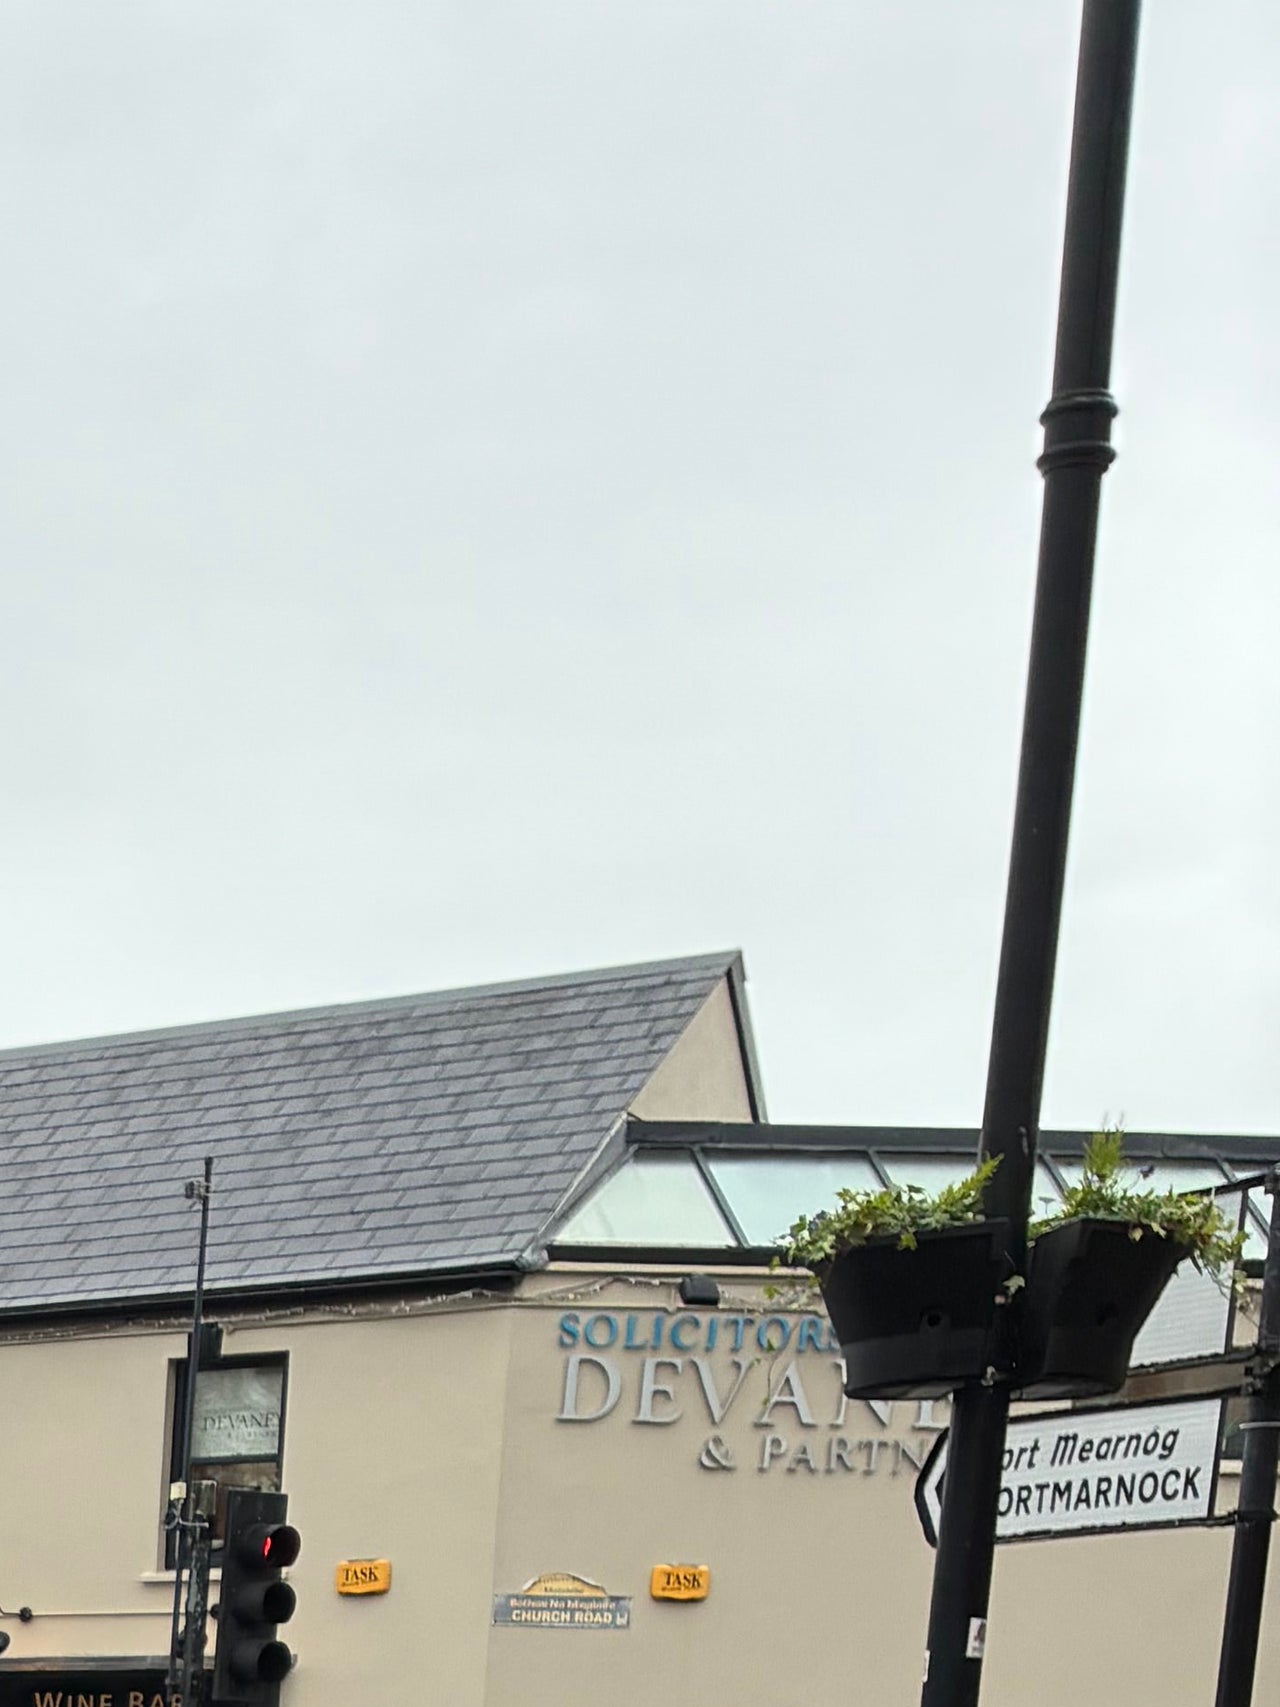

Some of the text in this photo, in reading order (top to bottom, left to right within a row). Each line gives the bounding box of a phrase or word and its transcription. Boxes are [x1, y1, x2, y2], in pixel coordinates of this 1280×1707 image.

[700, 1434, 930, 1476] & PARTN
[1001, 1425, 1180, 1471] ort Mearnóg
[996, 1466, 1202, 1517] ORTMARNOCK
[342, 1566, 379, 1582] TASK
[663, 1571, 702, 1588] TASK
[511, 1609, 613, 1624] CHURCH ROAD
